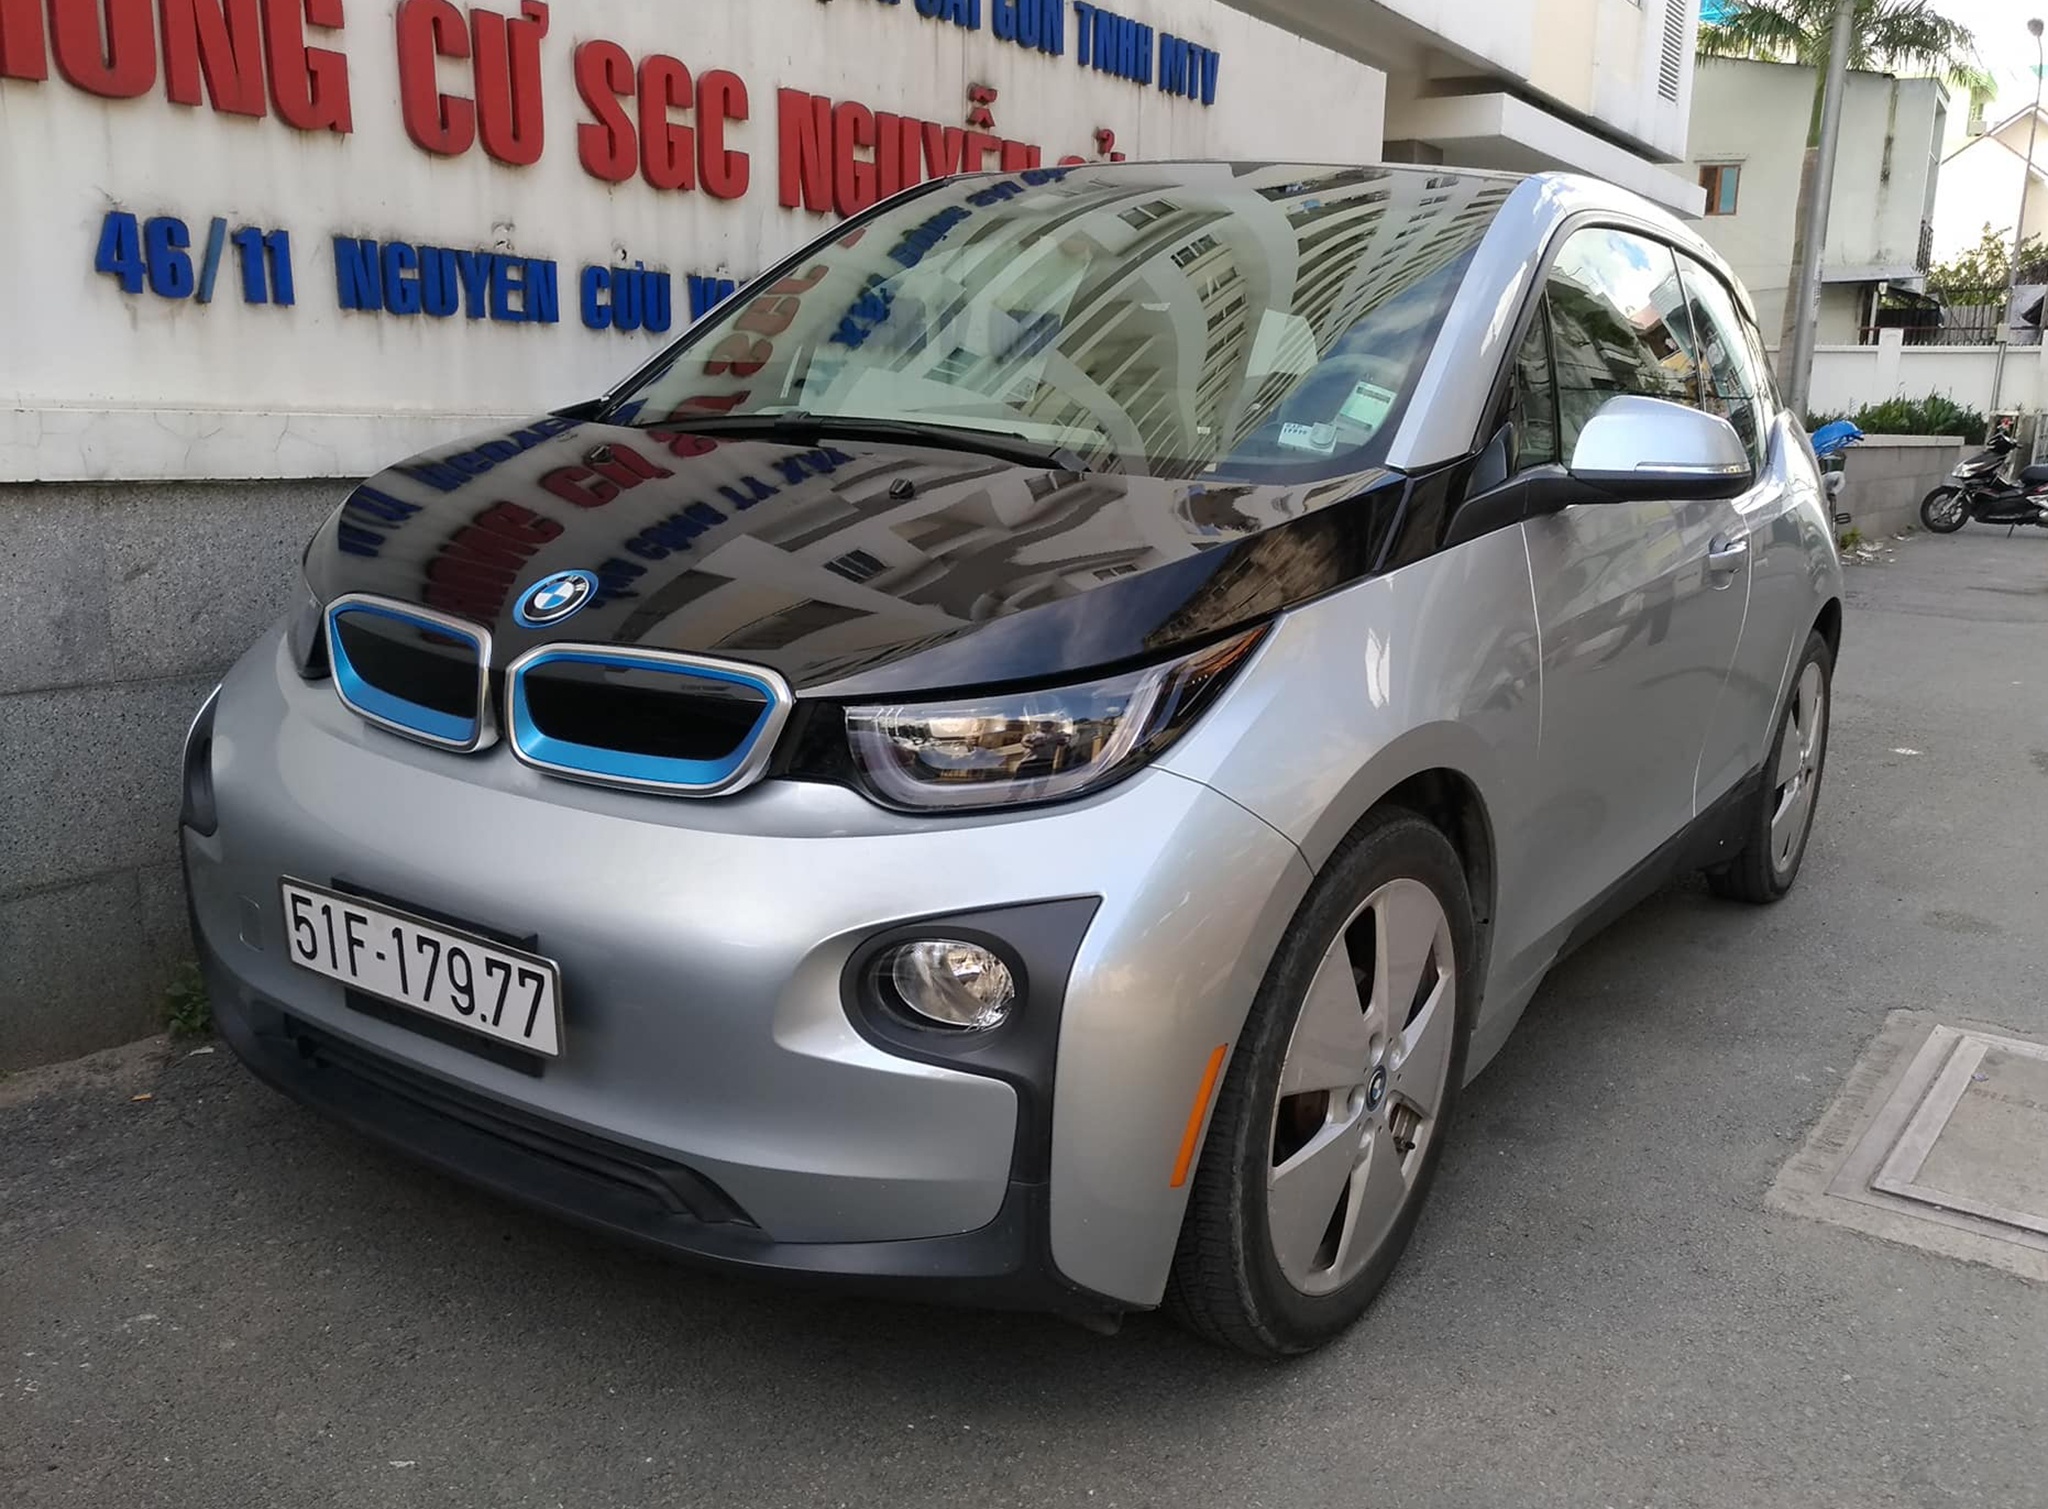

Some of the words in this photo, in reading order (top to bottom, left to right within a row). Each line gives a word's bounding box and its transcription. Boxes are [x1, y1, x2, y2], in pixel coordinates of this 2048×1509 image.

[0, 0, 353, 134] UNG
[575, 40, 749, 200] SGC
[1073, 0, 1153, 86] TNHH
[1158, 32, 1220, 105] MTV
[95, 210, 295, 306] 46/11
[290, 892, 546, 1039] 51F-179.77
